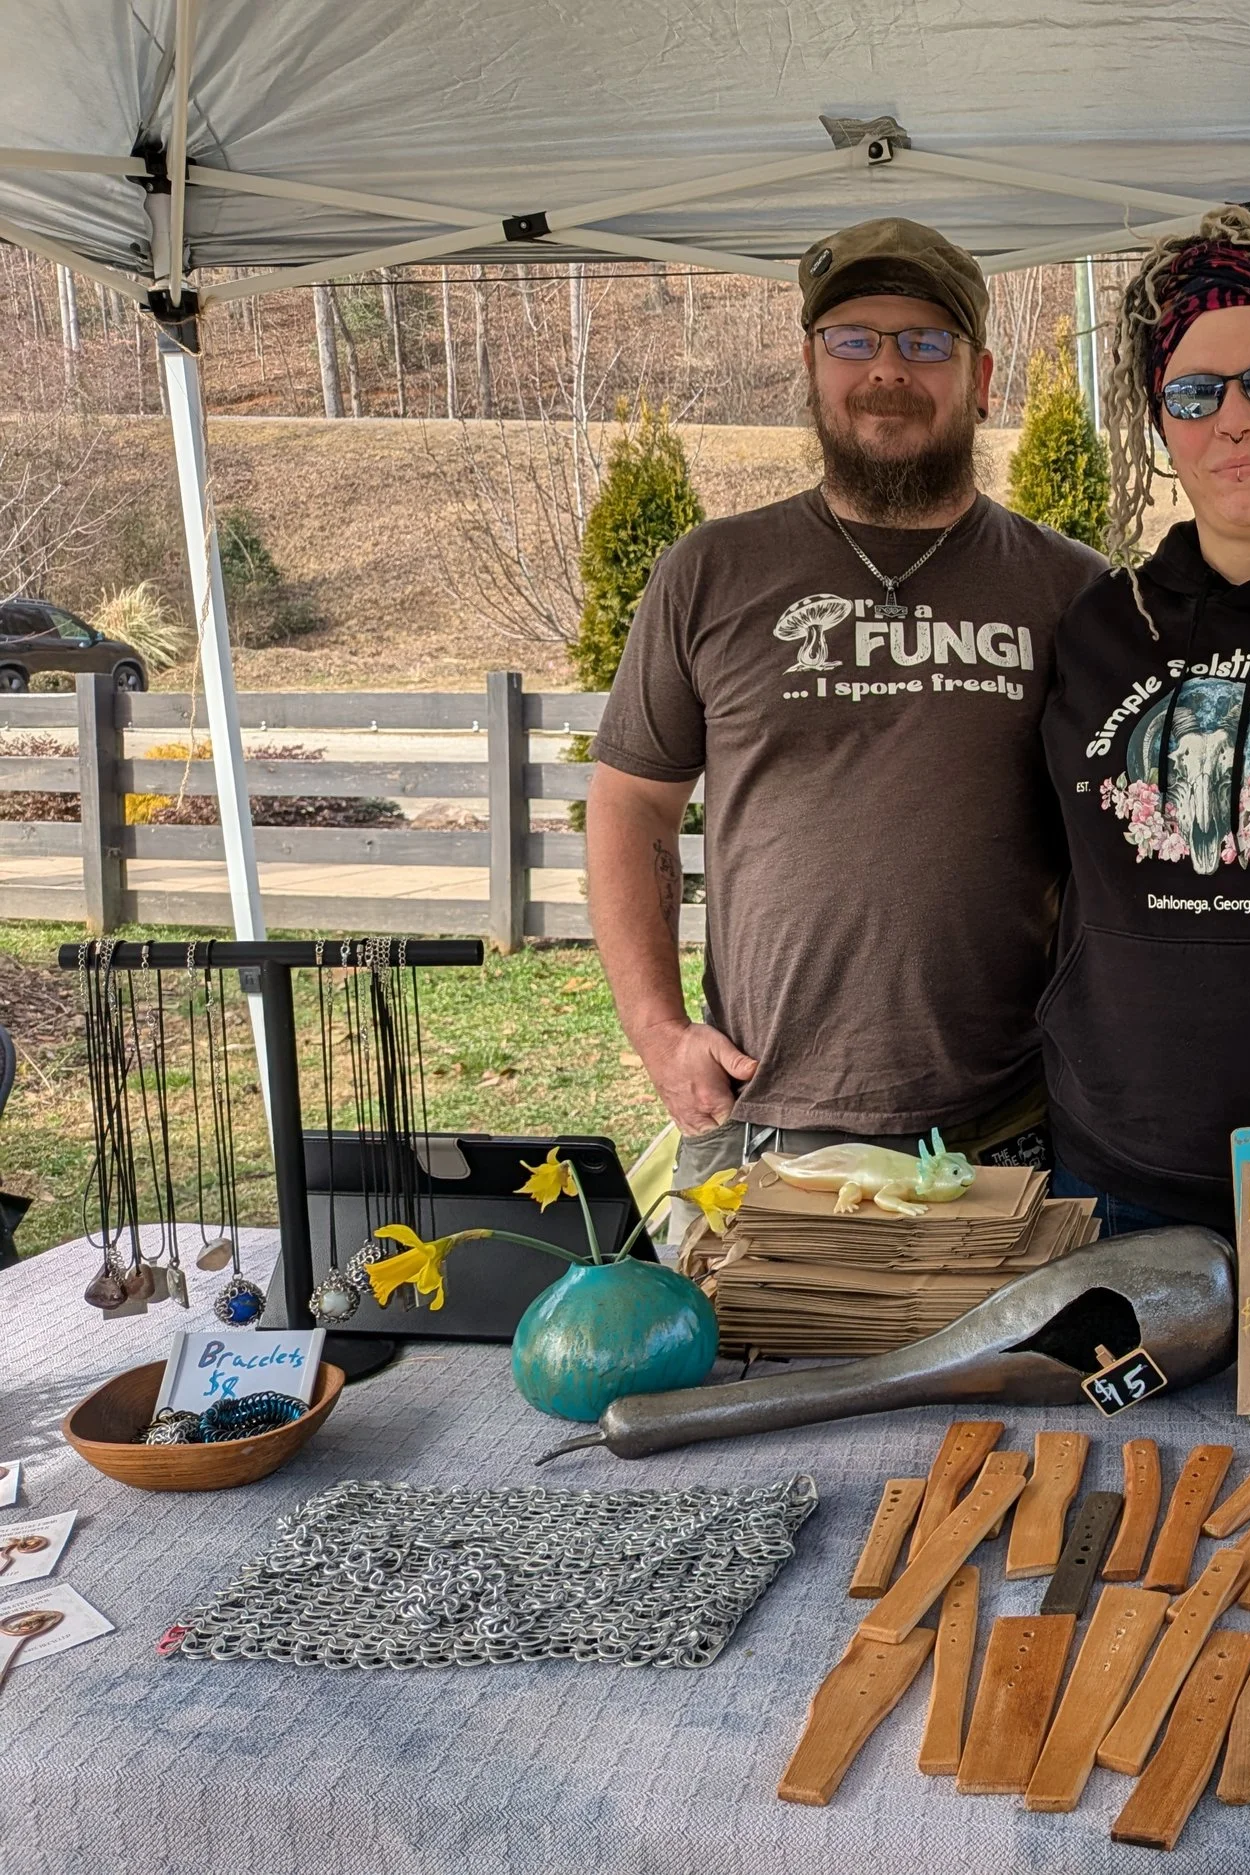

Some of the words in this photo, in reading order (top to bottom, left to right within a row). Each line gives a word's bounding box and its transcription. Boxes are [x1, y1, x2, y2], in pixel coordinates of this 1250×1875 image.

[915, 604, 932, 618] a
[856, 621, 1034, 670] FUNGI
[817, 678, 827, 697] I
[835, 679, 923, 701] spore
[932, 673, 1024, 700] freely
[1086, 676, 1162, 758] Simple
[1076, 781, 1091, 793] EST.
[1148, 894, 1211, 913] Dahlonega,
[198, 1340, 305, 1369] Bracelets
[203, 1369, 239, 1400] $8
